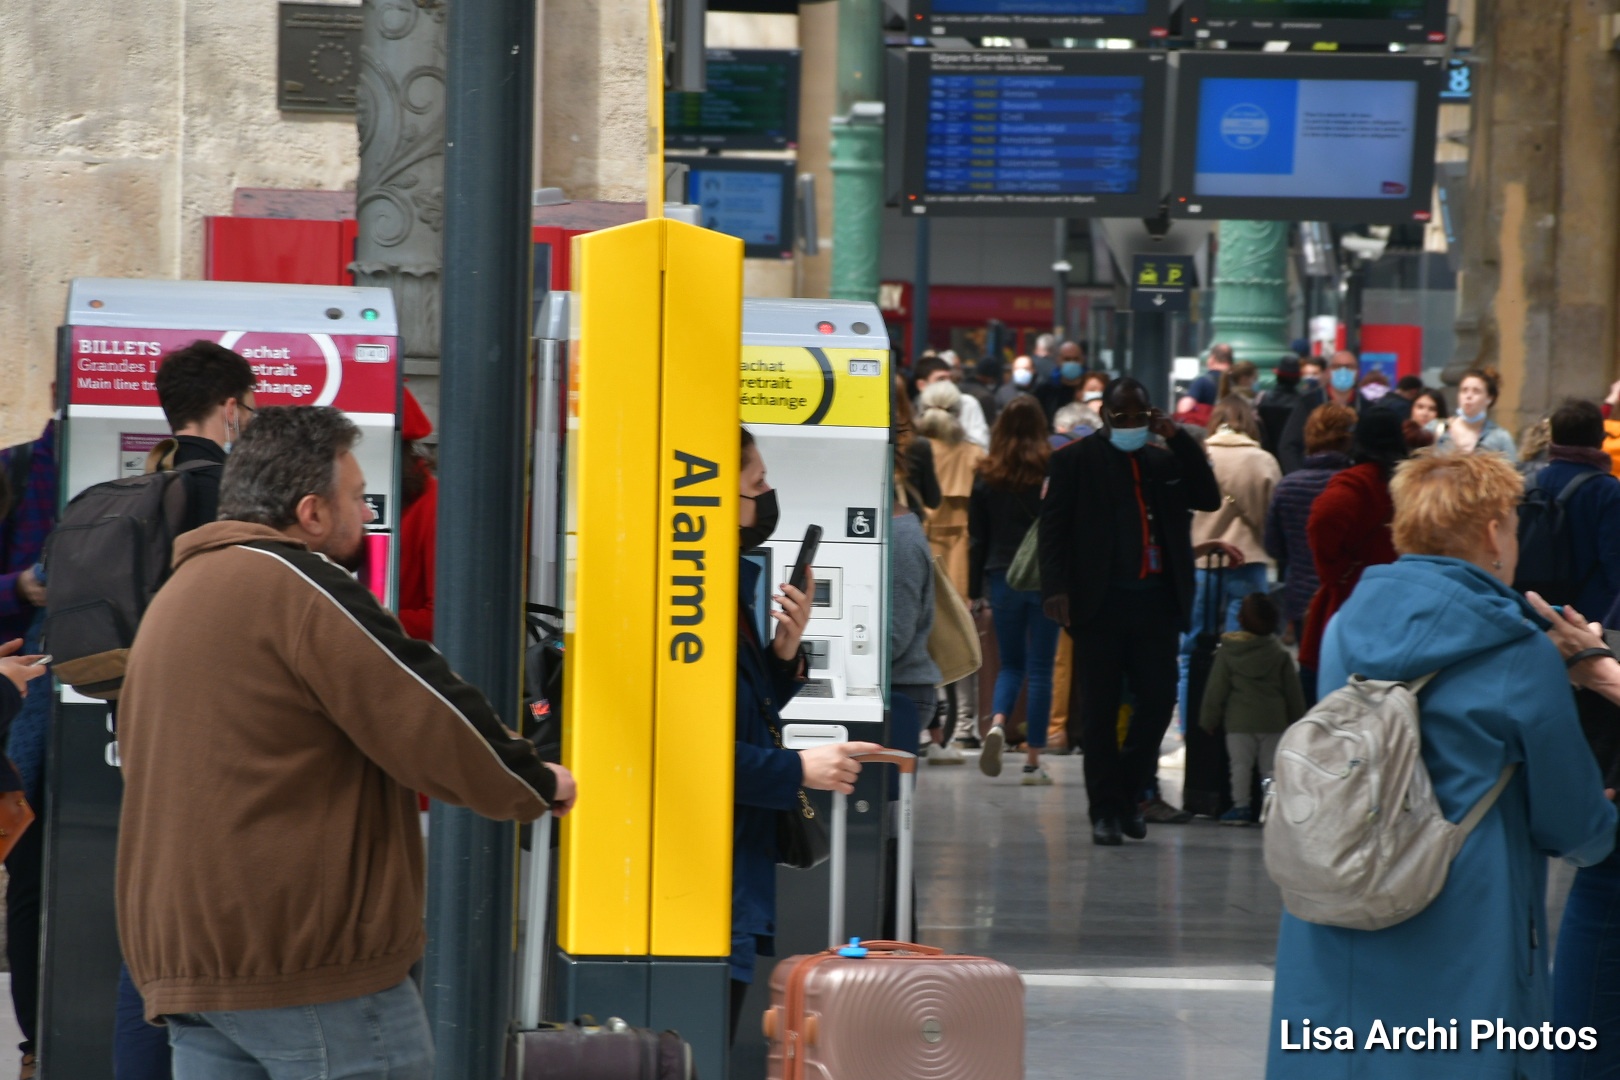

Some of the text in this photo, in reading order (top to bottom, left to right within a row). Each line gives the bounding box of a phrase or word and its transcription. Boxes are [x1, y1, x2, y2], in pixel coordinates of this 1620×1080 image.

[78, 339, 161, 356] BILLETS
[242, 345, 291, 360] achat
[78, 358, 146, 373] Grandes
[250, 363, 298, 377] etrait
[740, 360, 785, 373] achat
[77, 376, 112, 390] Main
[113, 378, 140, 391] line
[248, 379, 313, 398] change
[739, 392, 807, 410] échange
[670, 449, 721, 664] Alarme
